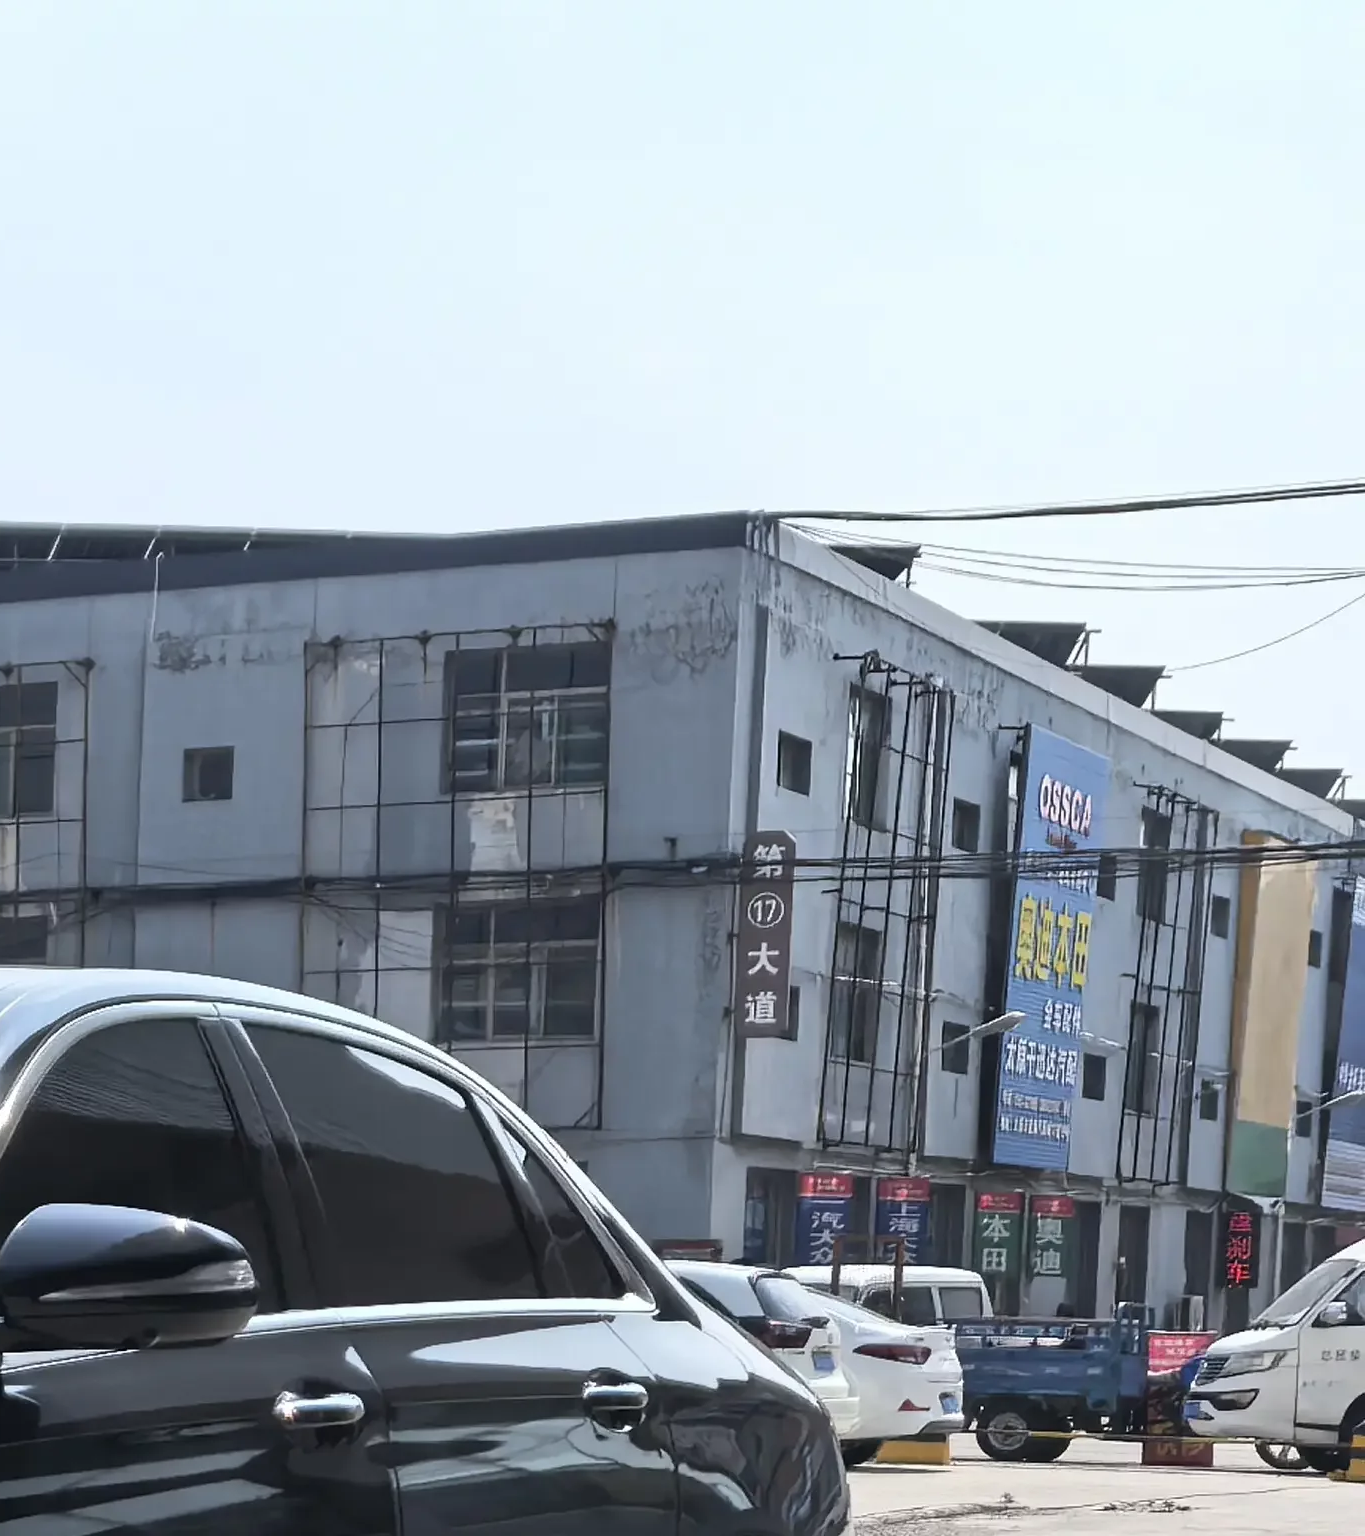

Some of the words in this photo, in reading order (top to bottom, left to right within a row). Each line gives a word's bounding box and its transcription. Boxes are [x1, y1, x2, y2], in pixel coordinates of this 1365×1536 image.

[1039, 774, 1093, 836] OSSCA
[981, 1213, 1011, 1273] 本田
[1033, 1211, 1065, 1275] 奥迪
